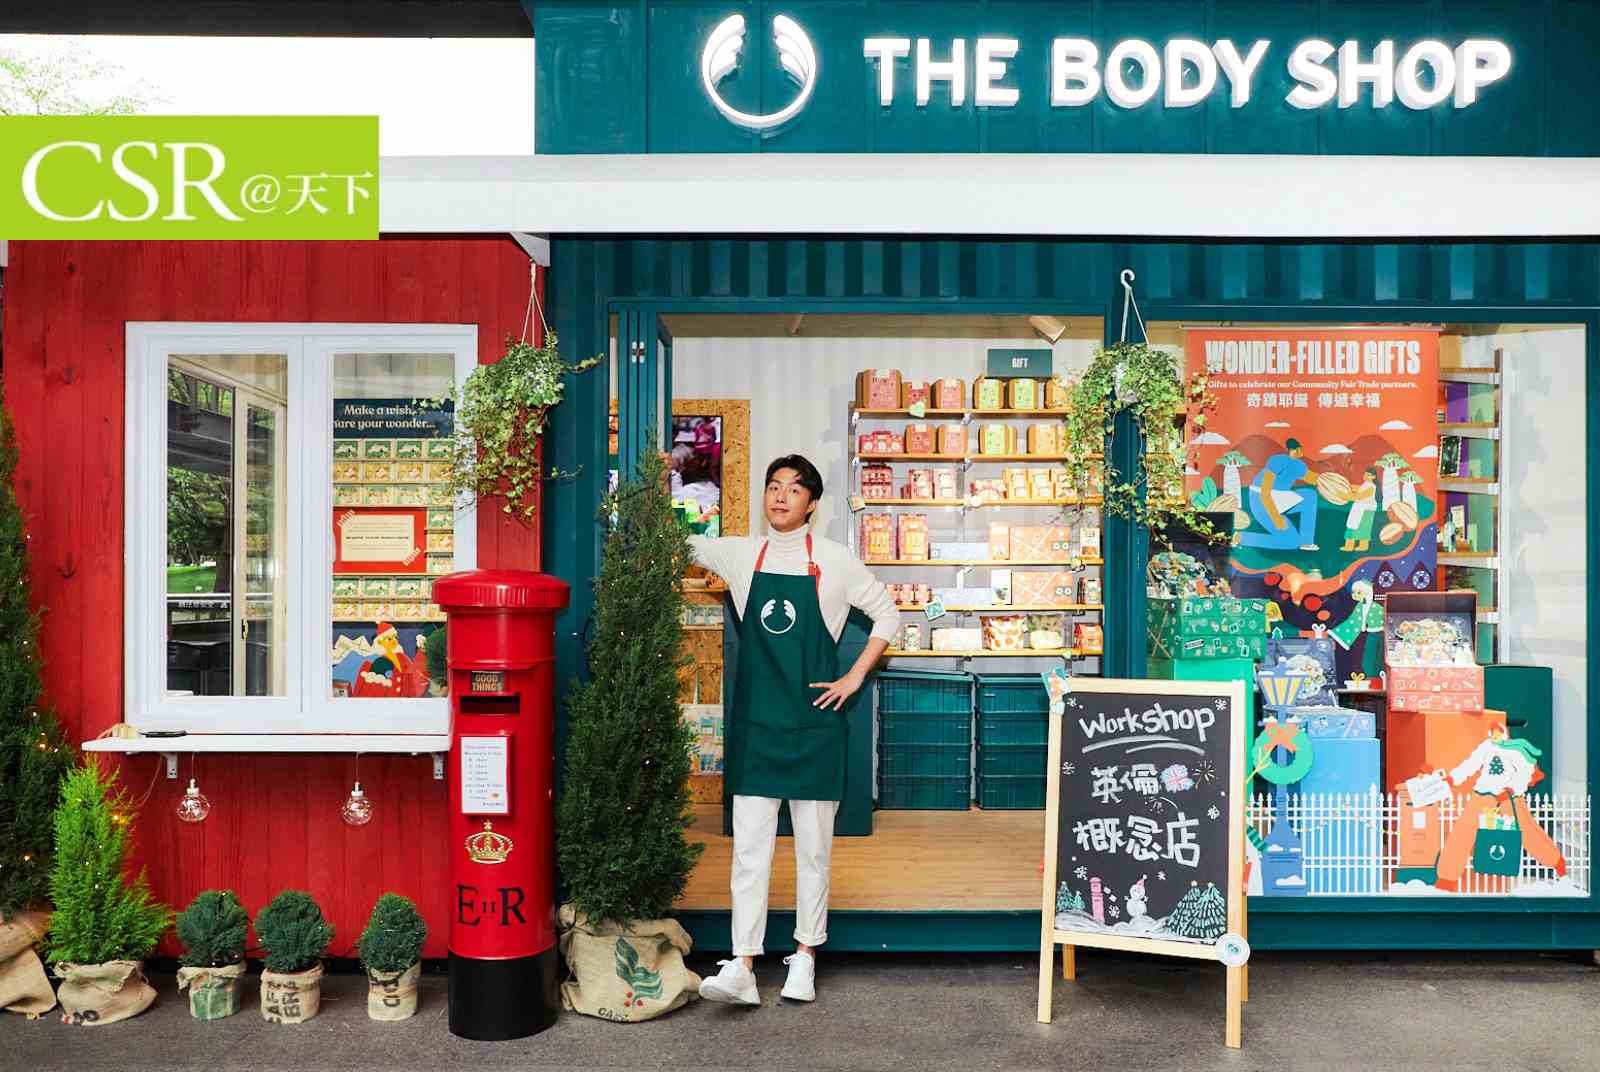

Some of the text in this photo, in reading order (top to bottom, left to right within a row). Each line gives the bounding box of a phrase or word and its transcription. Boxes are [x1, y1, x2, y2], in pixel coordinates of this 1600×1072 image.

[863, 37, 1512, 110] THE BODY SHOP
[1011, 357, 1029, 369] GIFT
[1204, 339, 1421, 375] WONDER-FILLED GIFTS
[1207, 381, 1227, 390] Gifts
[1228, 381, 1238, 390] to
[1239, 379, 1276, 390] celebrate
[1277, 382, 1292, 390] our
[1292, 380, 1340, 392] Community
[1341, 380, 1357, 389] Fair
[1357, 380, 1379, 389] Trade
[344, 404, 375, 416] Make
[376, 407, 384, 415] a
[357, 420, 384, 431] your
[475, 674, 498, 683] GOOD
[1078, 702, 1216, 743] Workshop
[1072, 812, 1201, 868] 概念店
